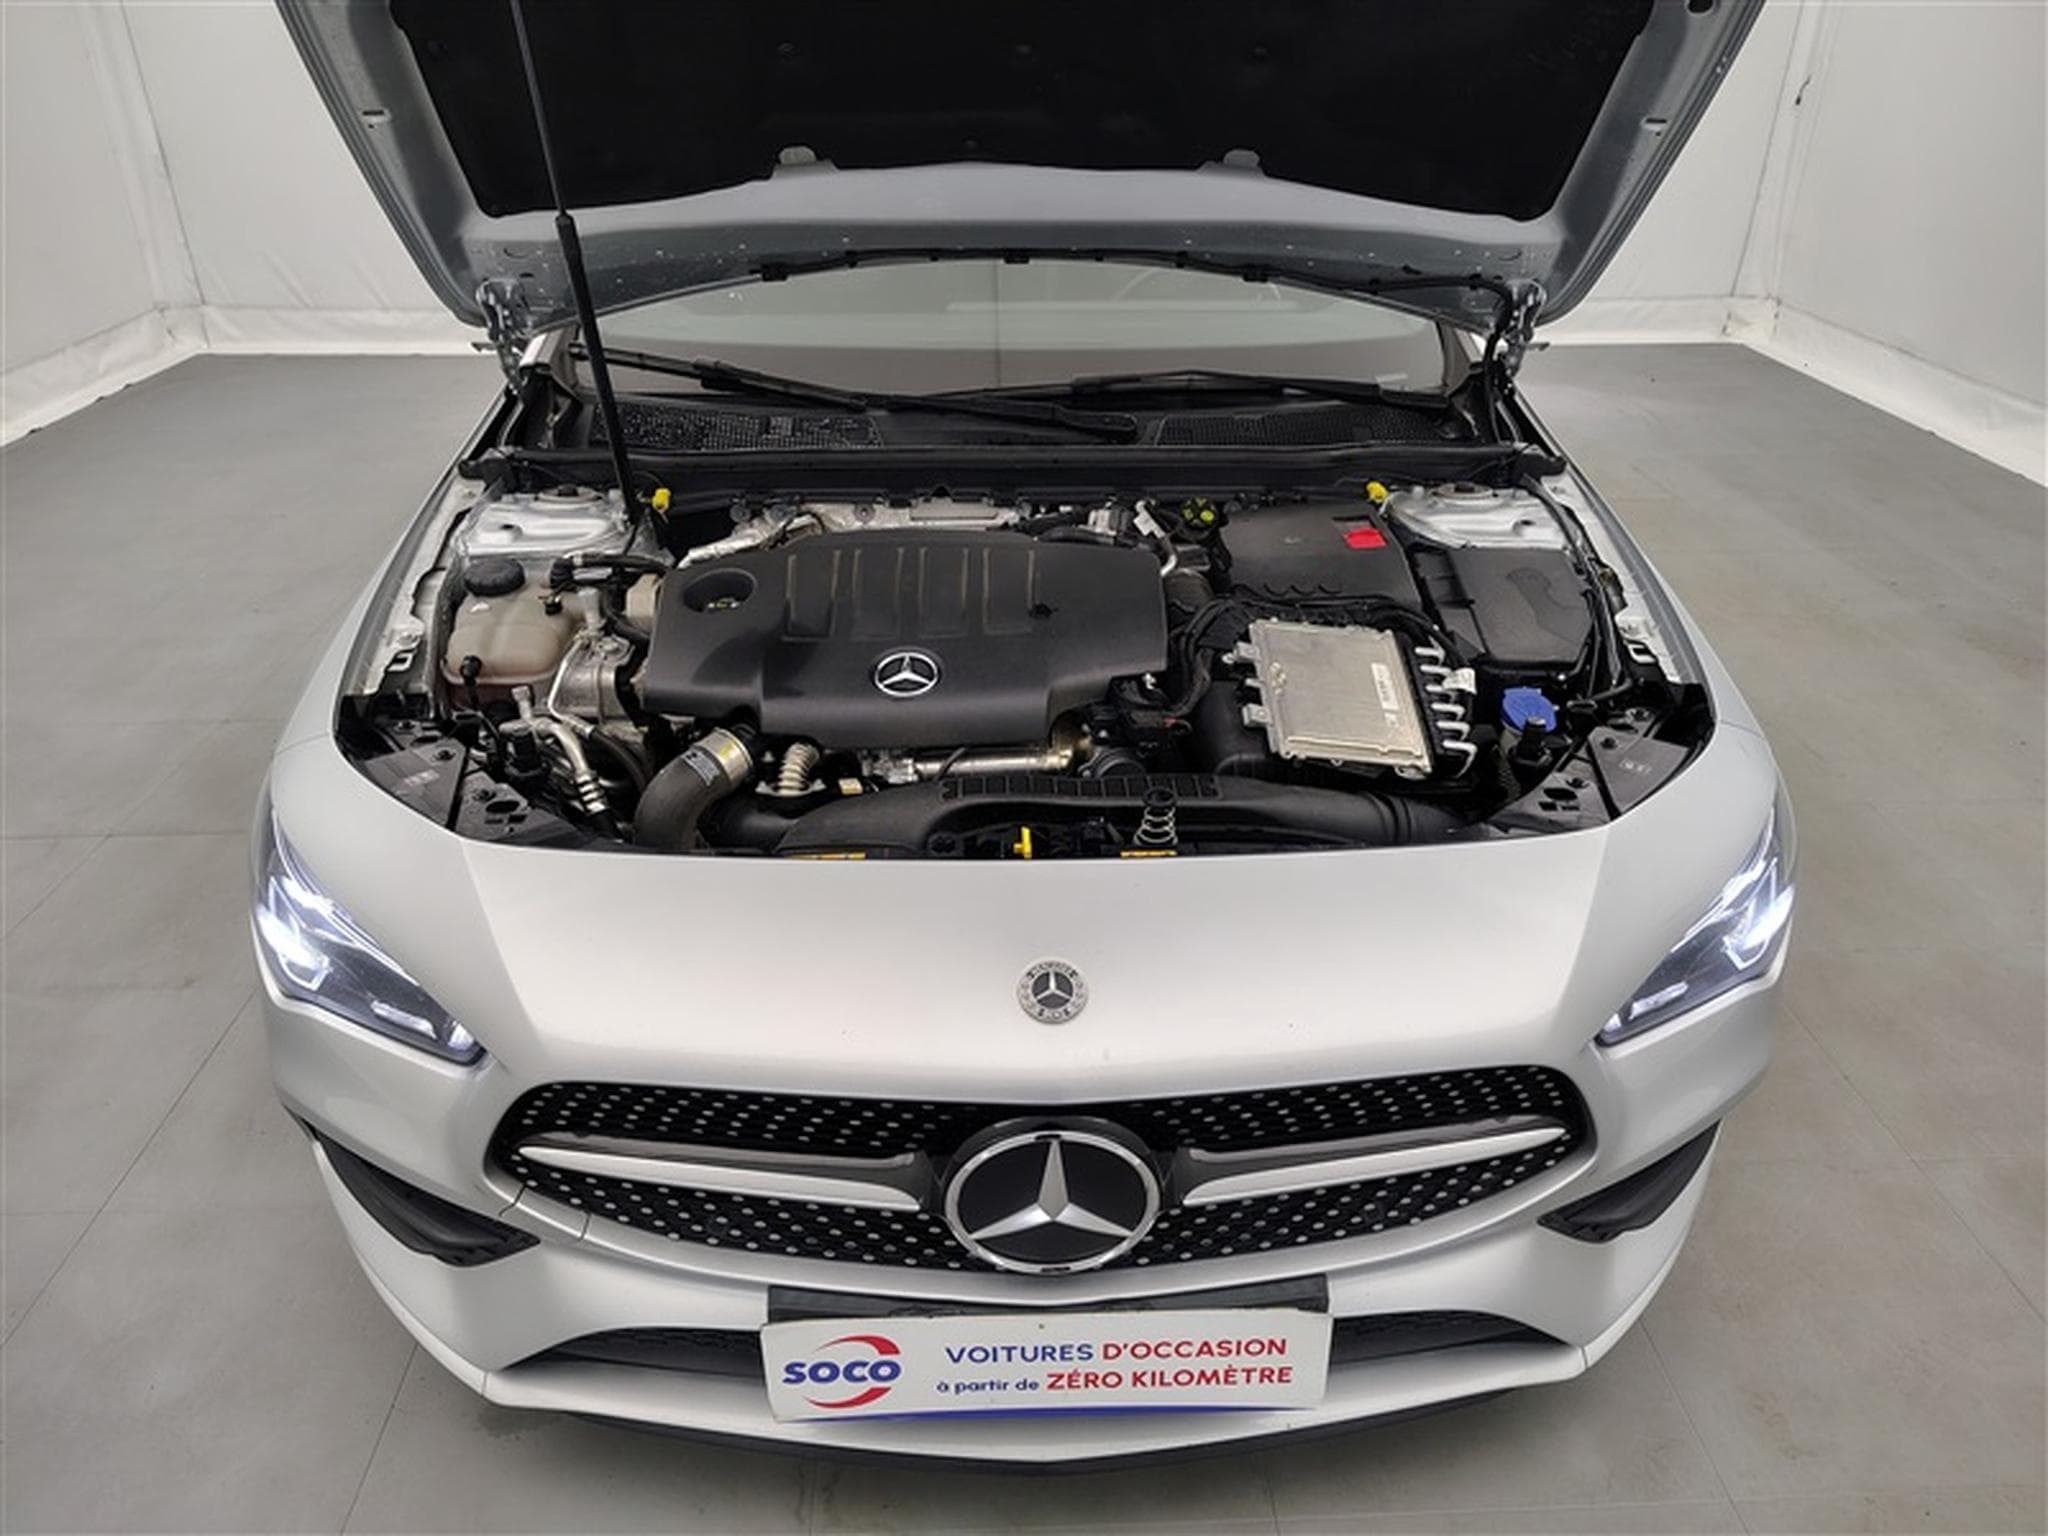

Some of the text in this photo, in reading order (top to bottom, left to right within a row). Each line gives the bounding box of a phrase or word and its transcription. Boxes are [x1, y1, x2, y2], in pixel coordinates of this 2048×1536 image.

[944, 1337, 1287, 1364] VOITURES D'OCCASION
[782, 1359, 901, 1385] SOCO
[954, 1378, 1010, 1396] partir
[1014, 1377, 1040, 1391] de
[1046, 1368, 1123, 1390] ZÉRO
[1131, 1363, 1294, 1388] KILOMÈTRE
